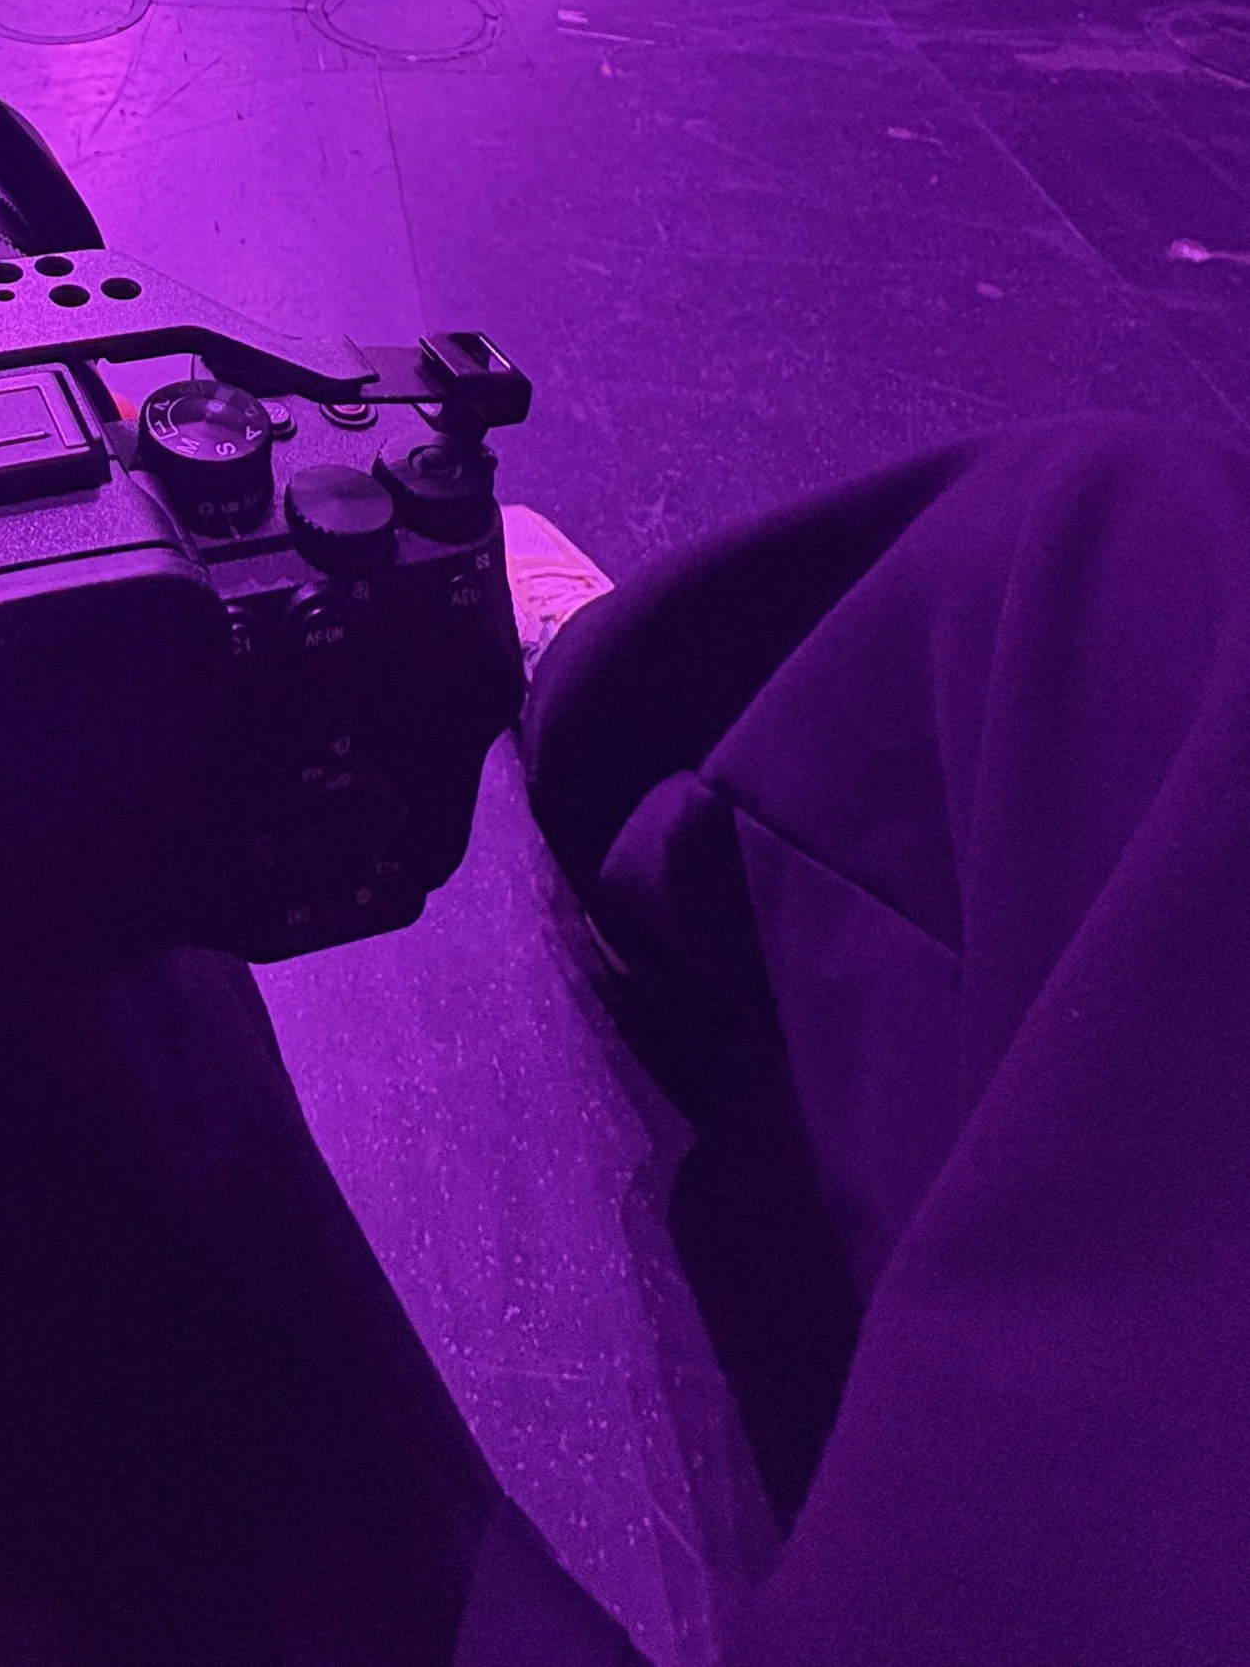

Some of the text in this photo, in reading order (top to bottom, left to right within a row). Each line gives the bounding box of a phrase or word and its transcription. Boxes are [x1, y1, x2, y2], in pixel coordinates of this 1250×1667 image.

[246, 425, 262, 441] A
[176, 437, 200, 455] M
[215, 442, 237, 456] S
